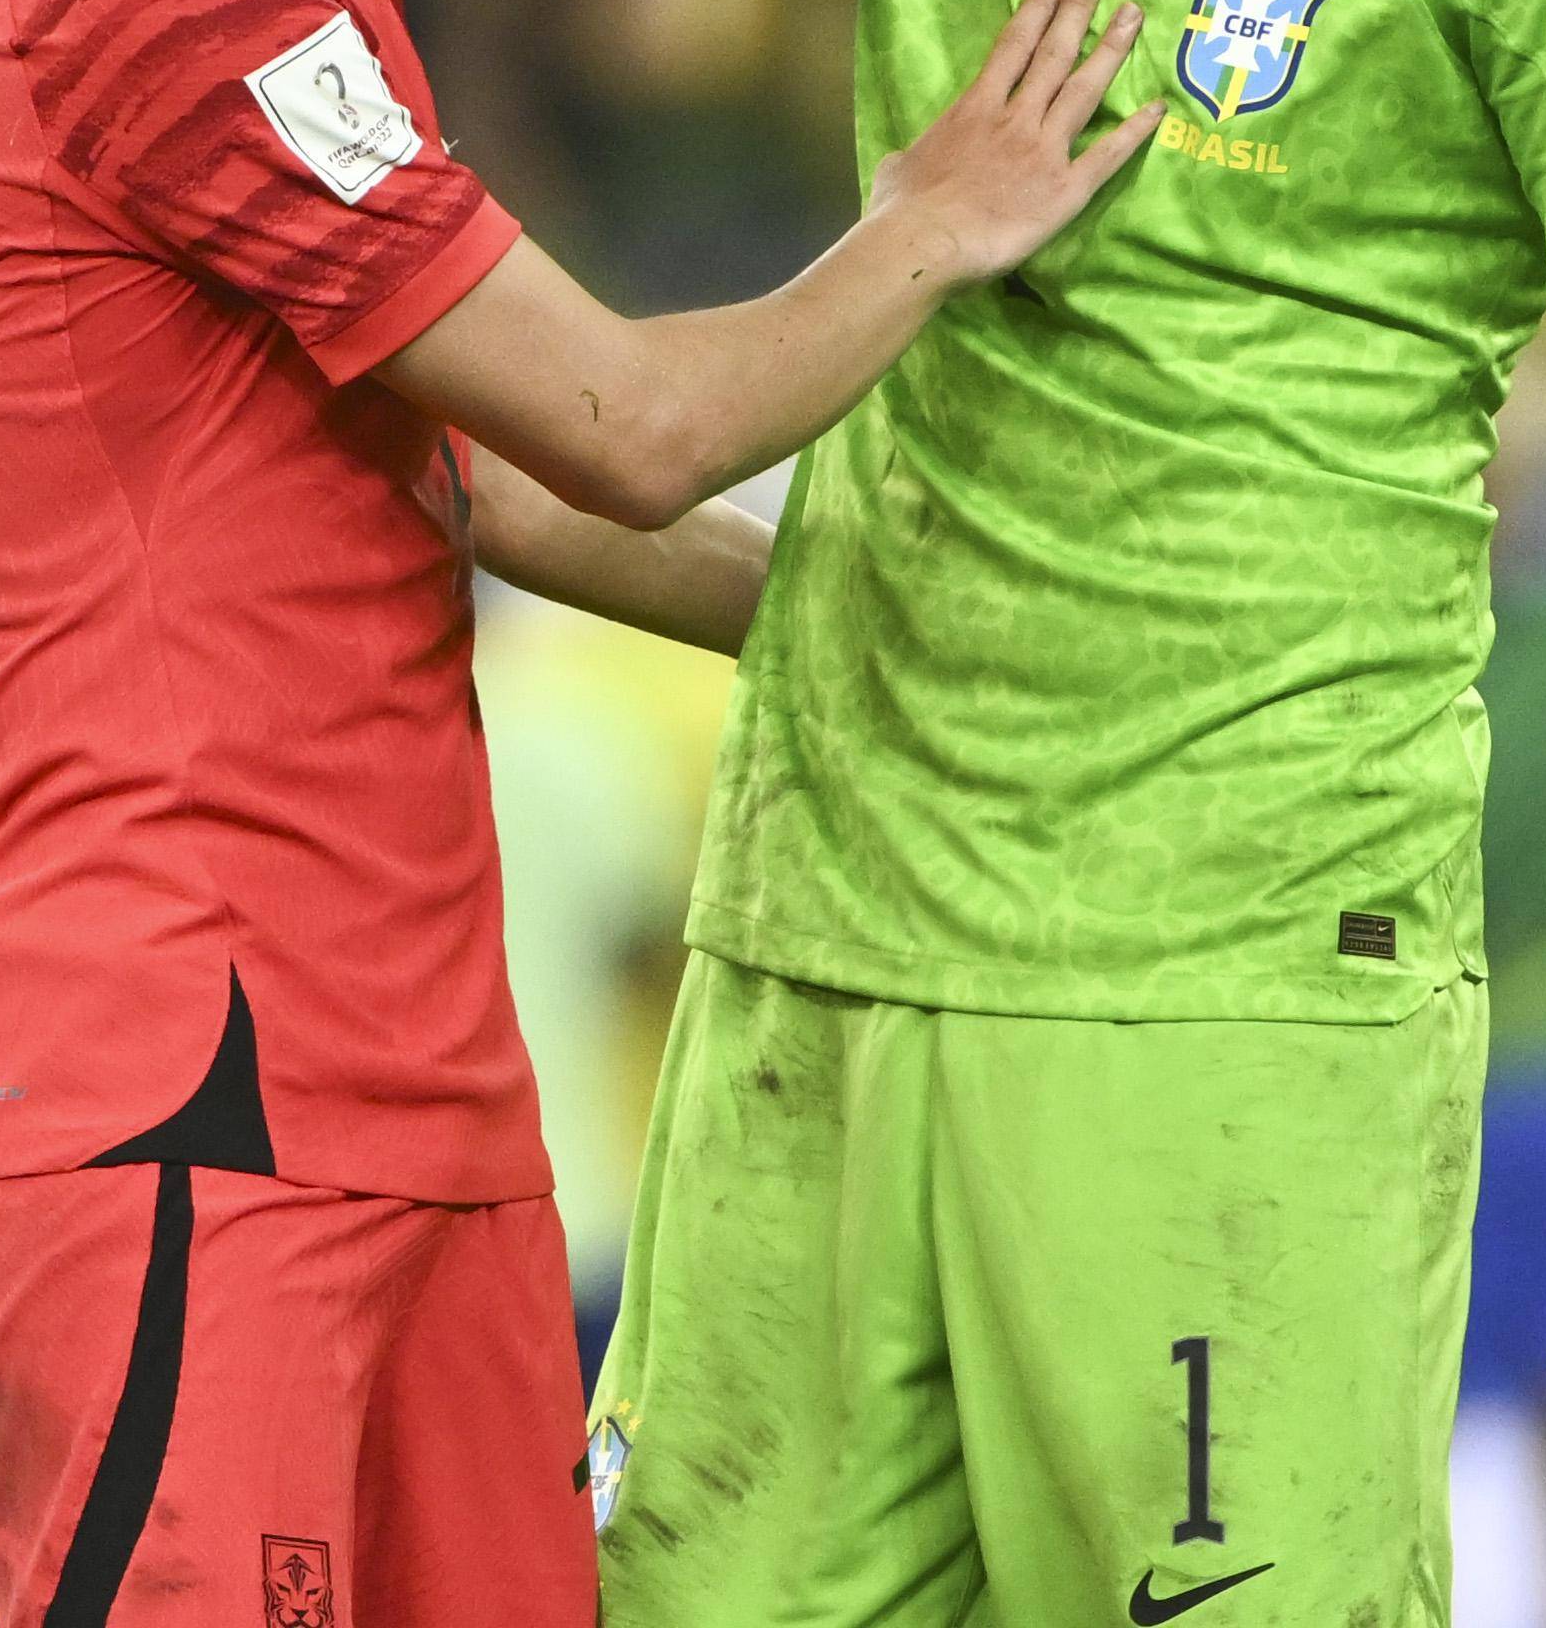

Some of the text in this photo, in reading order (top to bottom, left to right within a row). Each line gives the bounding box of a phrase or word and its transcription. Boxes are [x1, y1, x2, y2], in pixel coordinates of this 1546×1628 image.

[1223, 14, 1274, 40] CBF
[350, 128, 376, 150] WOD
[376, 114, 390, 131] CUP
[1157, 115, 1289, 174] BRASIL
[1170, 1336, 1225, 1545] 1
